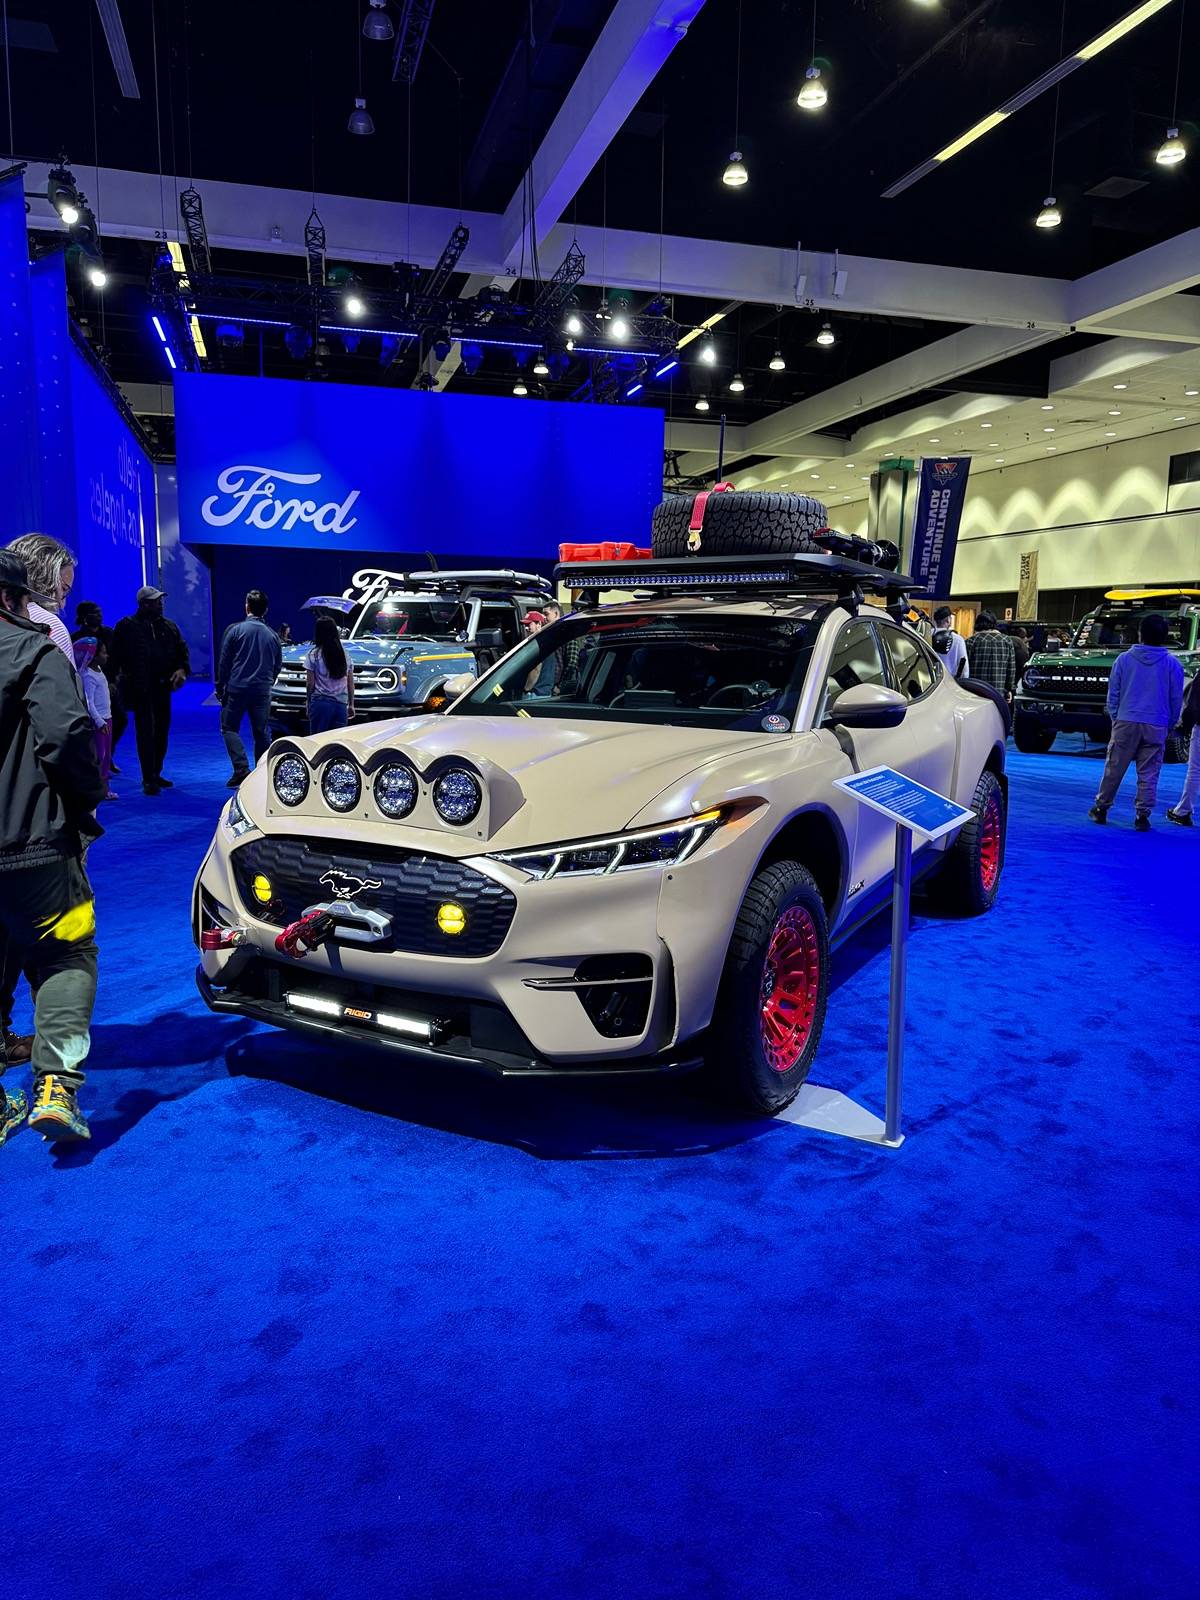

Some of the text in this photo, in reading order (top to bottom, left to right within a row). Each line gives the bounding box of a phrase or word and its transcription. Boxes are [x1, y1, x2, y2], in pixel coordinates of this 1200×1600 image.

[154, 230, 168, 239] 23
[805, 298, 814, 306] 25
[201, 465, 361, 534] Ford
[920, 489, 941, 576] ADVENTURE
[931, 488, 951, 563] CONTINUE
[927, 566, 939, 593] THE
[344, 1007, 372, 1019] RIGID
